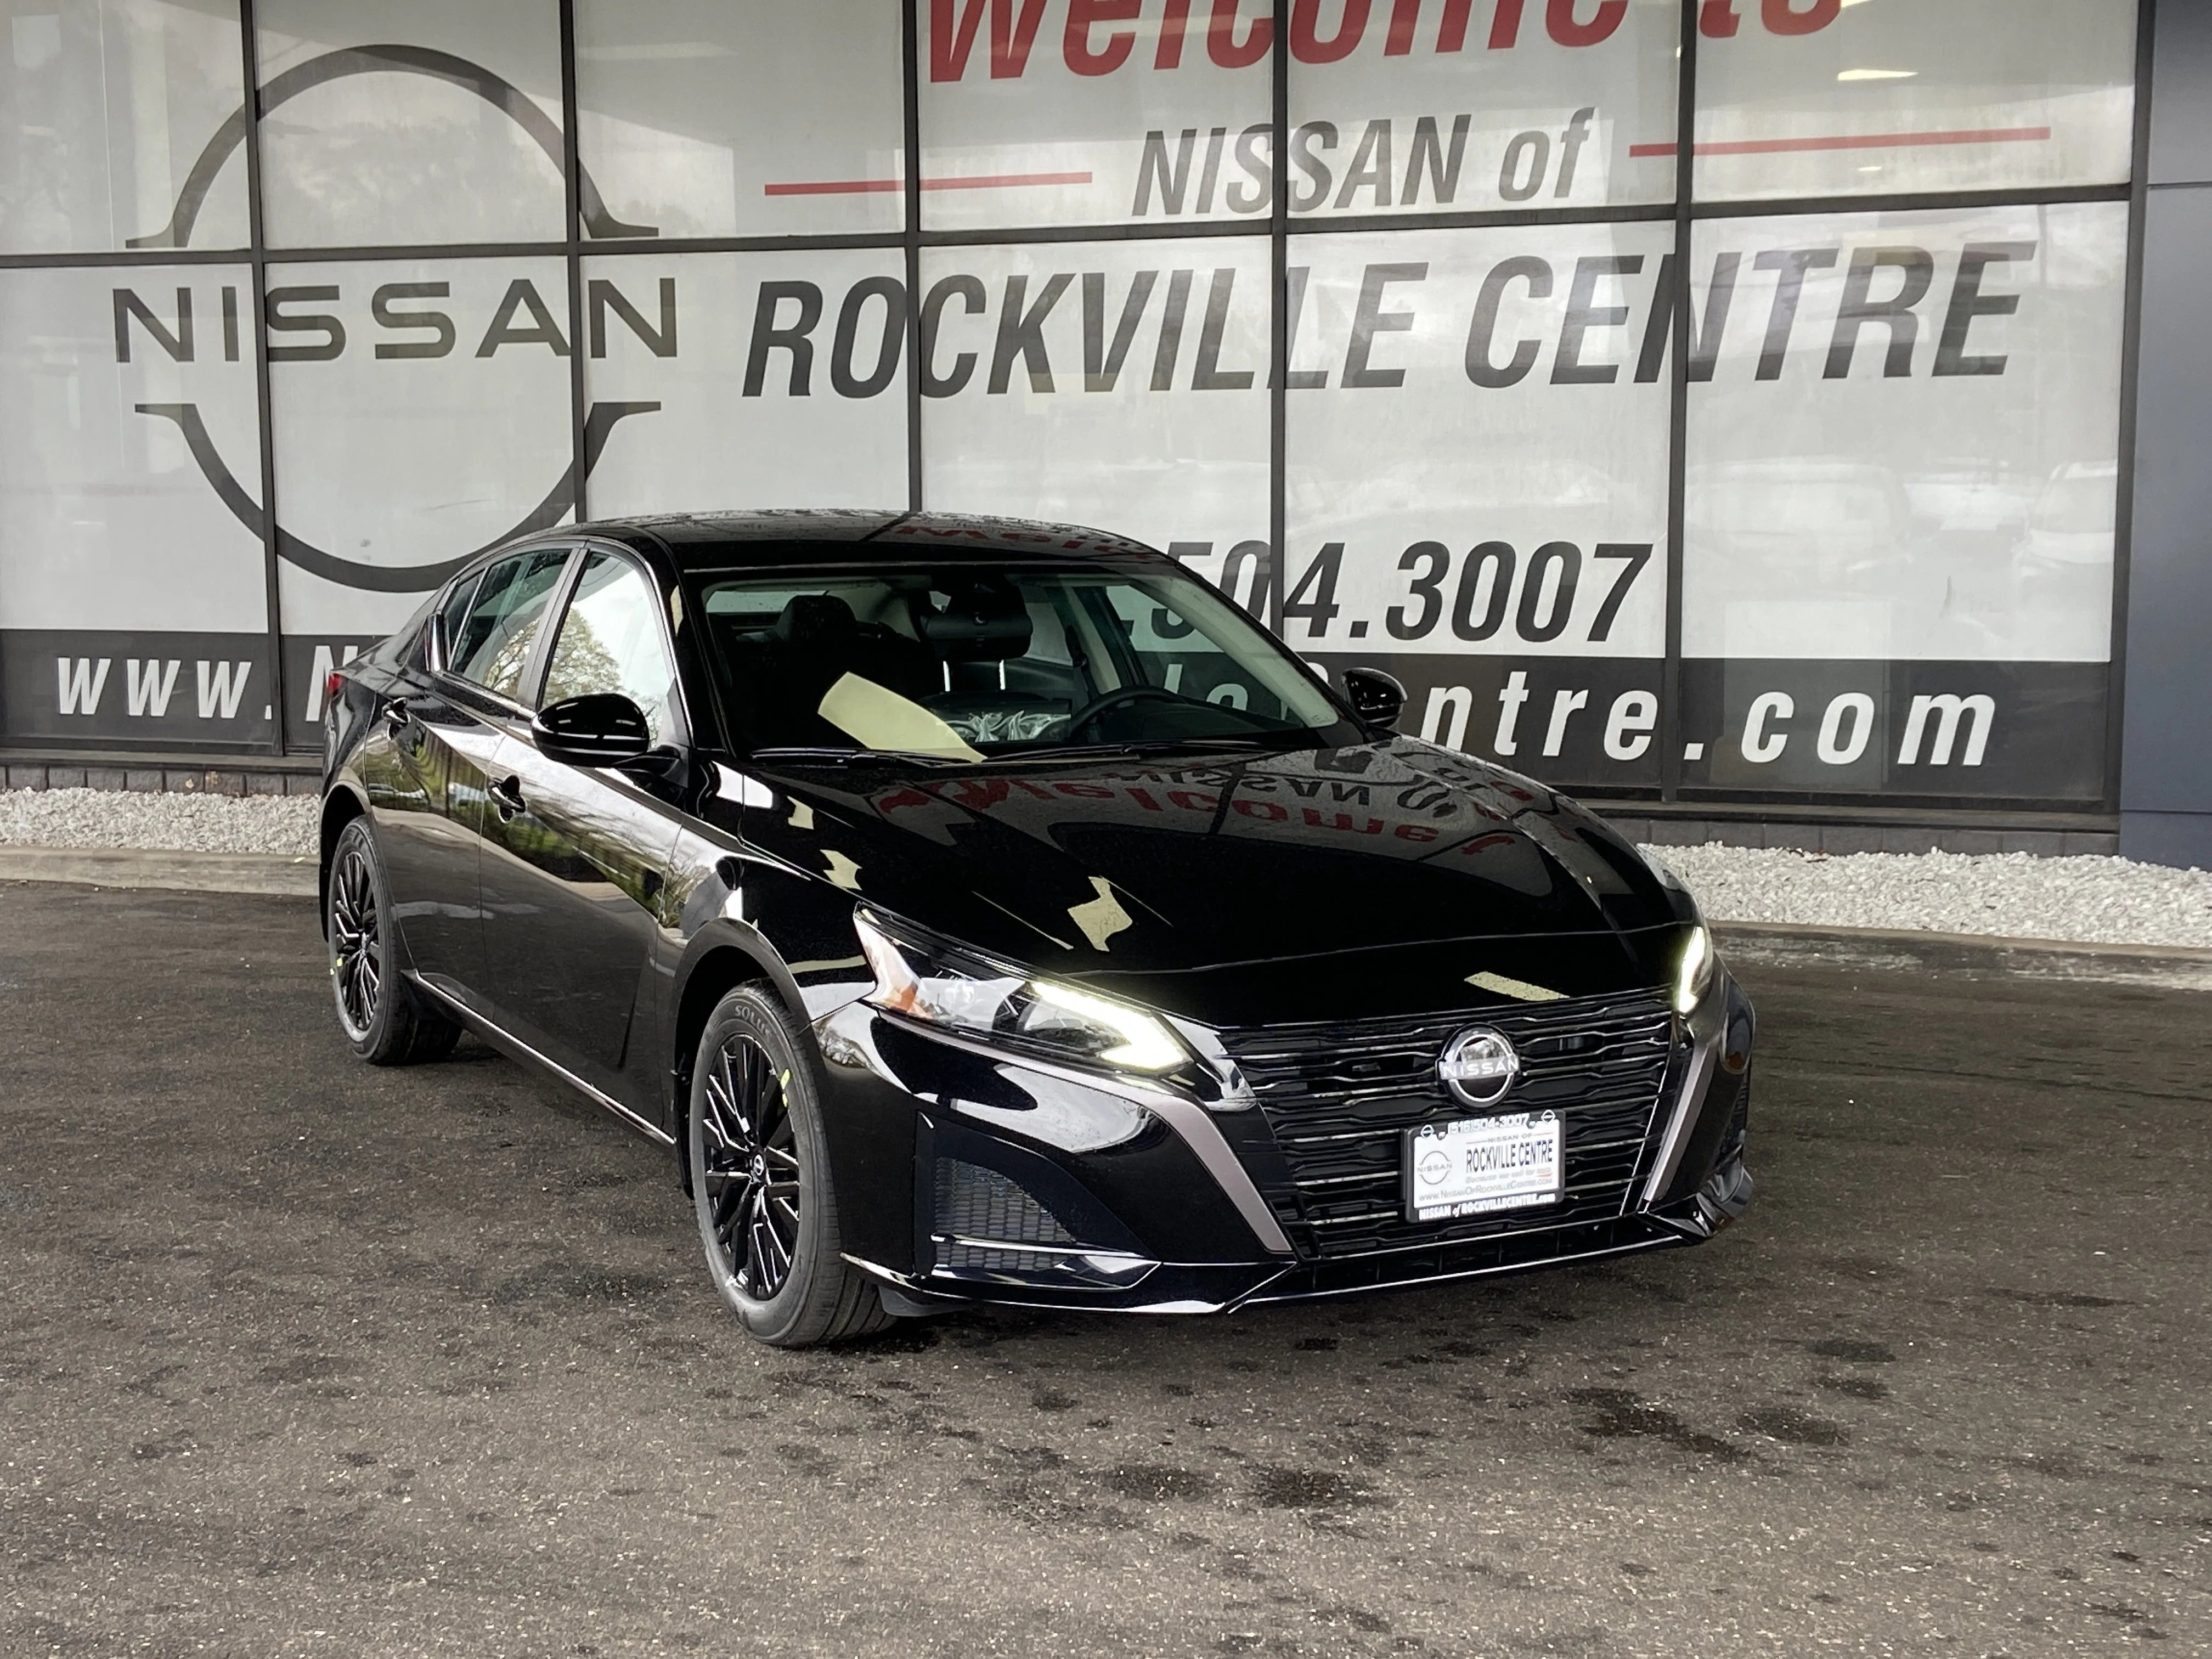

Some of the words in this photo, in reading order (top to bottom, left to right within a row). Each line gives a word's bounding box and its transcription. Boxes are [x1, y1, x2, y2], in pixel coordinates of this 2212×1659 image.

[1132, 115, 1471, 216] NISSAN
[1499, 106, 1595, 201] of
[113, 278, 677, 362] NISSAN
[742, 262, 1429, 399] ROCKVILLE
[1465, 240, 2038, 388] CENTRE
[1443, 1057, 1519, 1077] NISSAN
[1487, 1134, 1519, 1143] NISSAN
[1417, 1163, 1452, 1173] NISSAN
[1466, 1143, 1516, 1173] ROCKVILLE
[1519, 1139, 1553, 1166] CENTRE
